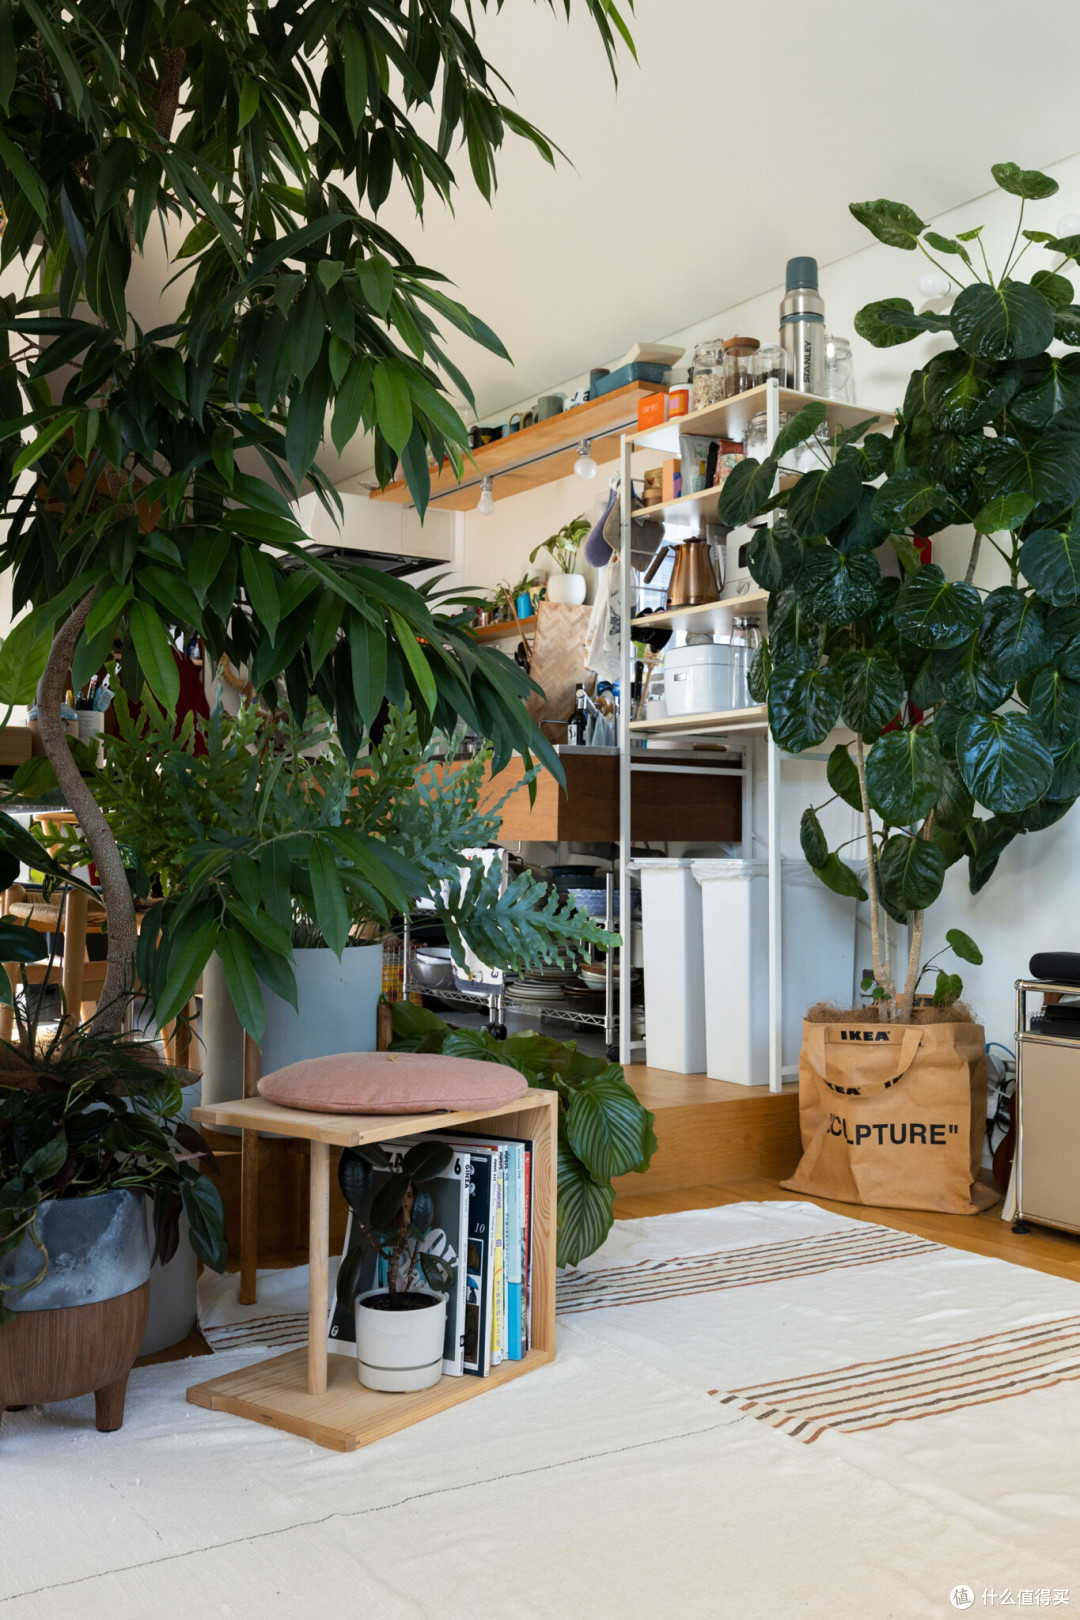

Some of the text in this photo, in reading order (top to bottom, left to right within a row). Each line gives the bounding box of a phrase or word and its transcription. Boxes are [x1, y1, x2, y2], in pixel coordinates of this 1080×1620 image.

[803, 340, 811, 383] STANLEY
[840, 1030, 890, 1041] IKEA
[454, 1158, 461, 1175] 6
[475, 1223, 485, 1233] 10
[331, 1325, 339, 1337] G
